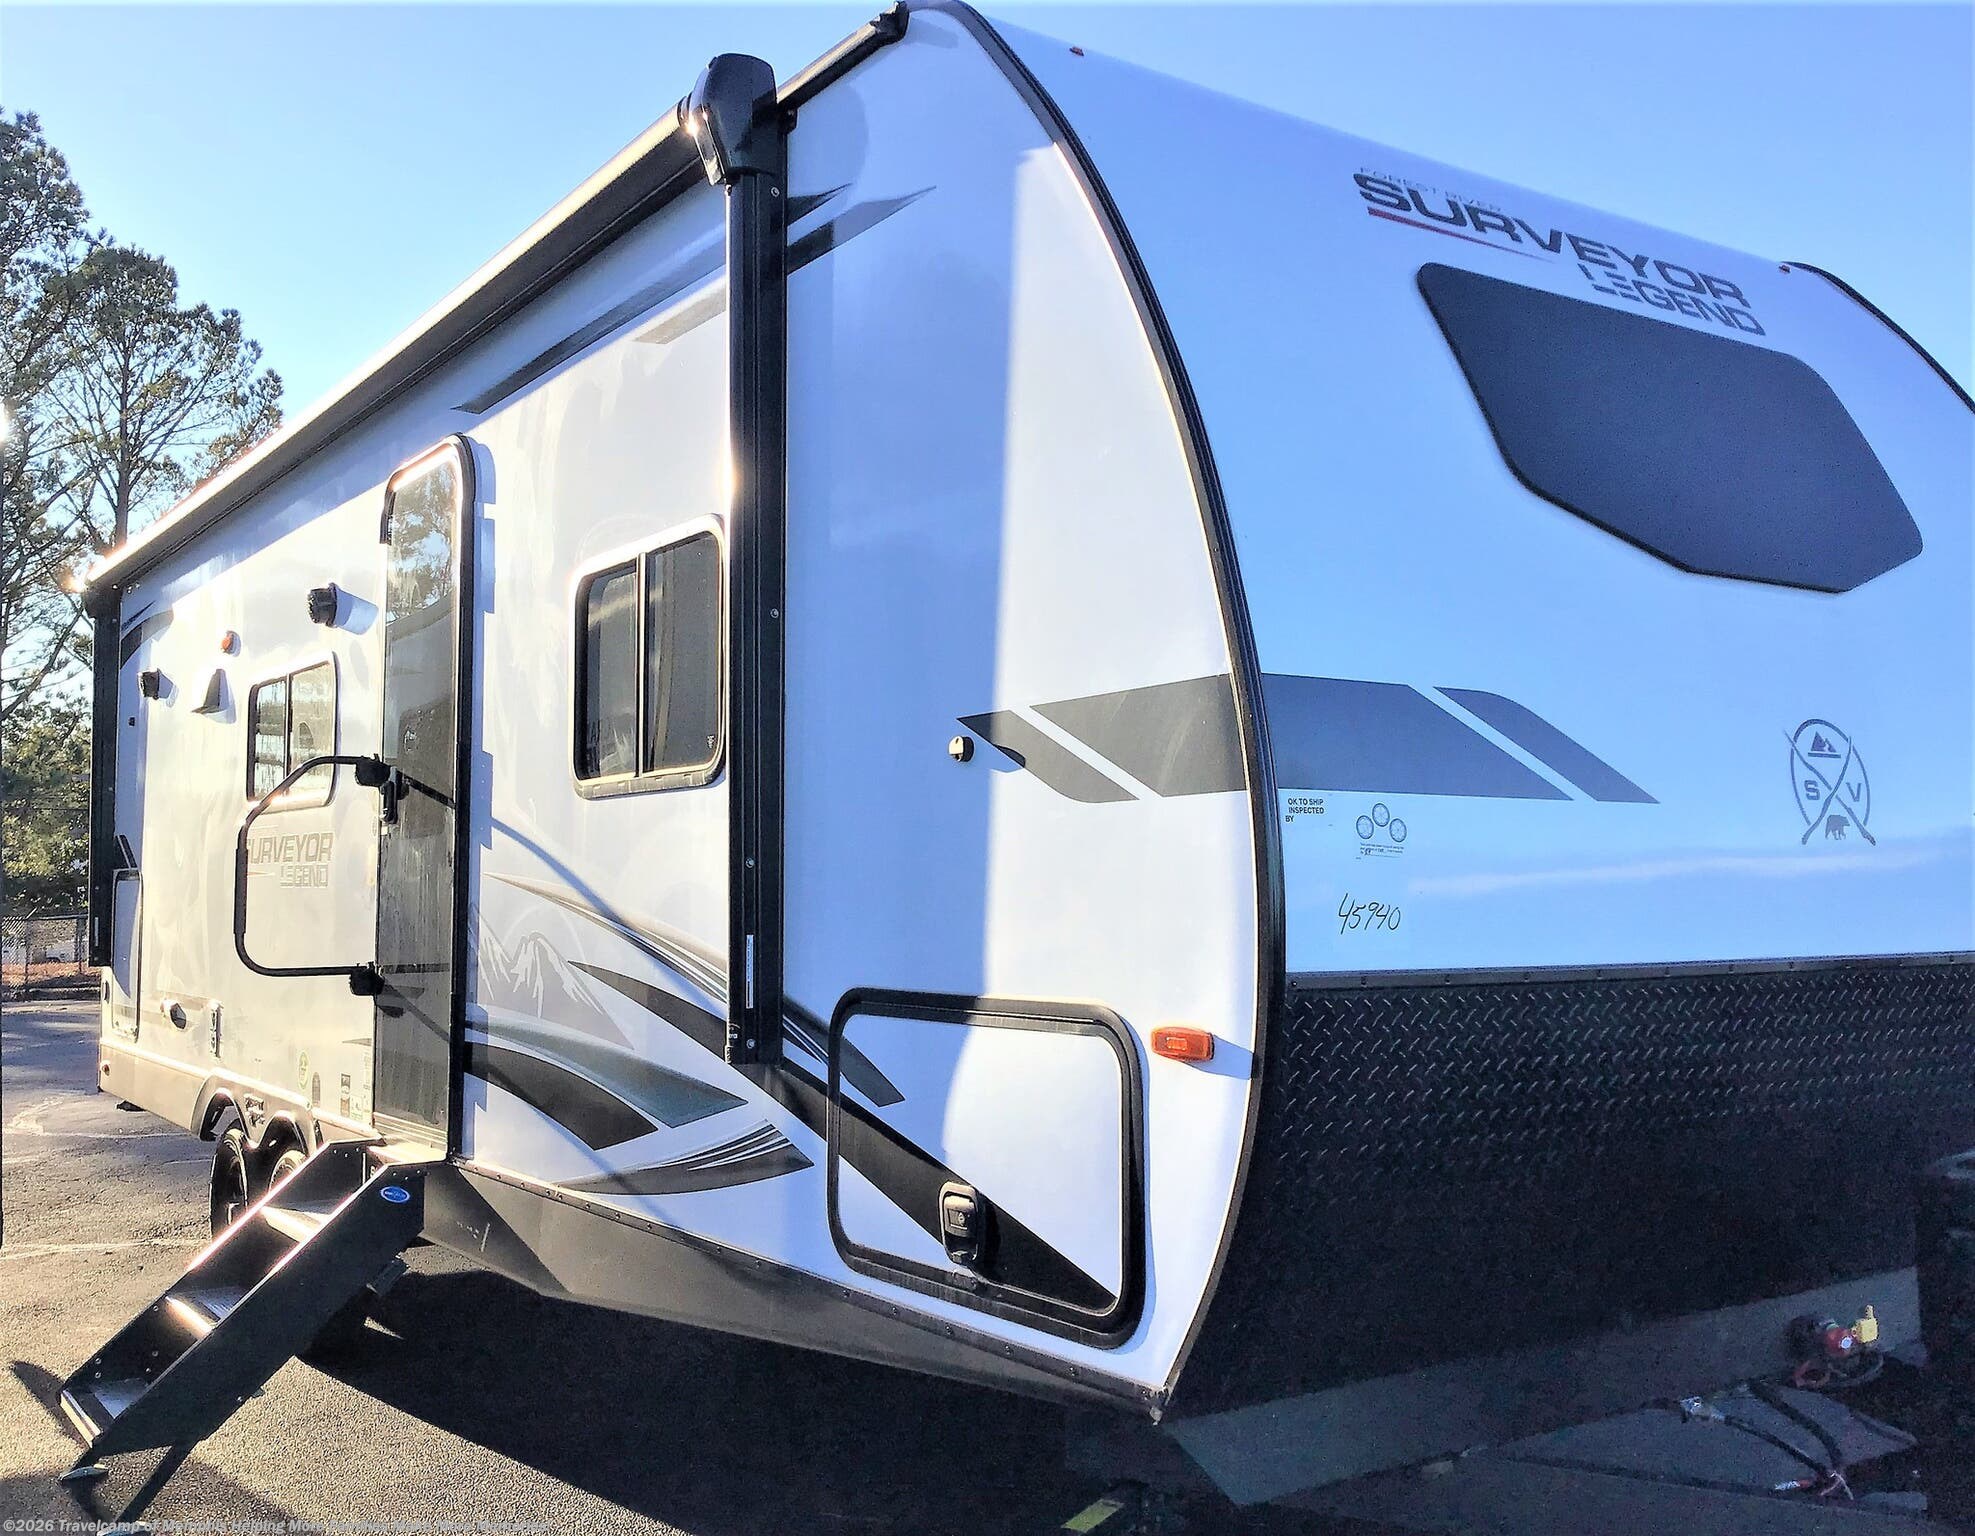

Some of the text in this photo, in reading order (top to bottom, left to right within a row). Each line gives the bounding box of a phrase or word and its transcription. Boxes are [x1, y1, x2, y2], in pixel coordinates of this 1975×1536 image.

[1353, 173, 1752, 309] SURVEYOR
[1578, 262, 1766, 337] LEGEND
[1287, 798, 1324, 806] OK TO SHIP
[1804, 779, 1861, 802] S V
[1285, 815, 1294, 823] BY
[280, 864, 329, 887] LEGEND
[1338, 893, 1401, 935] 45940
